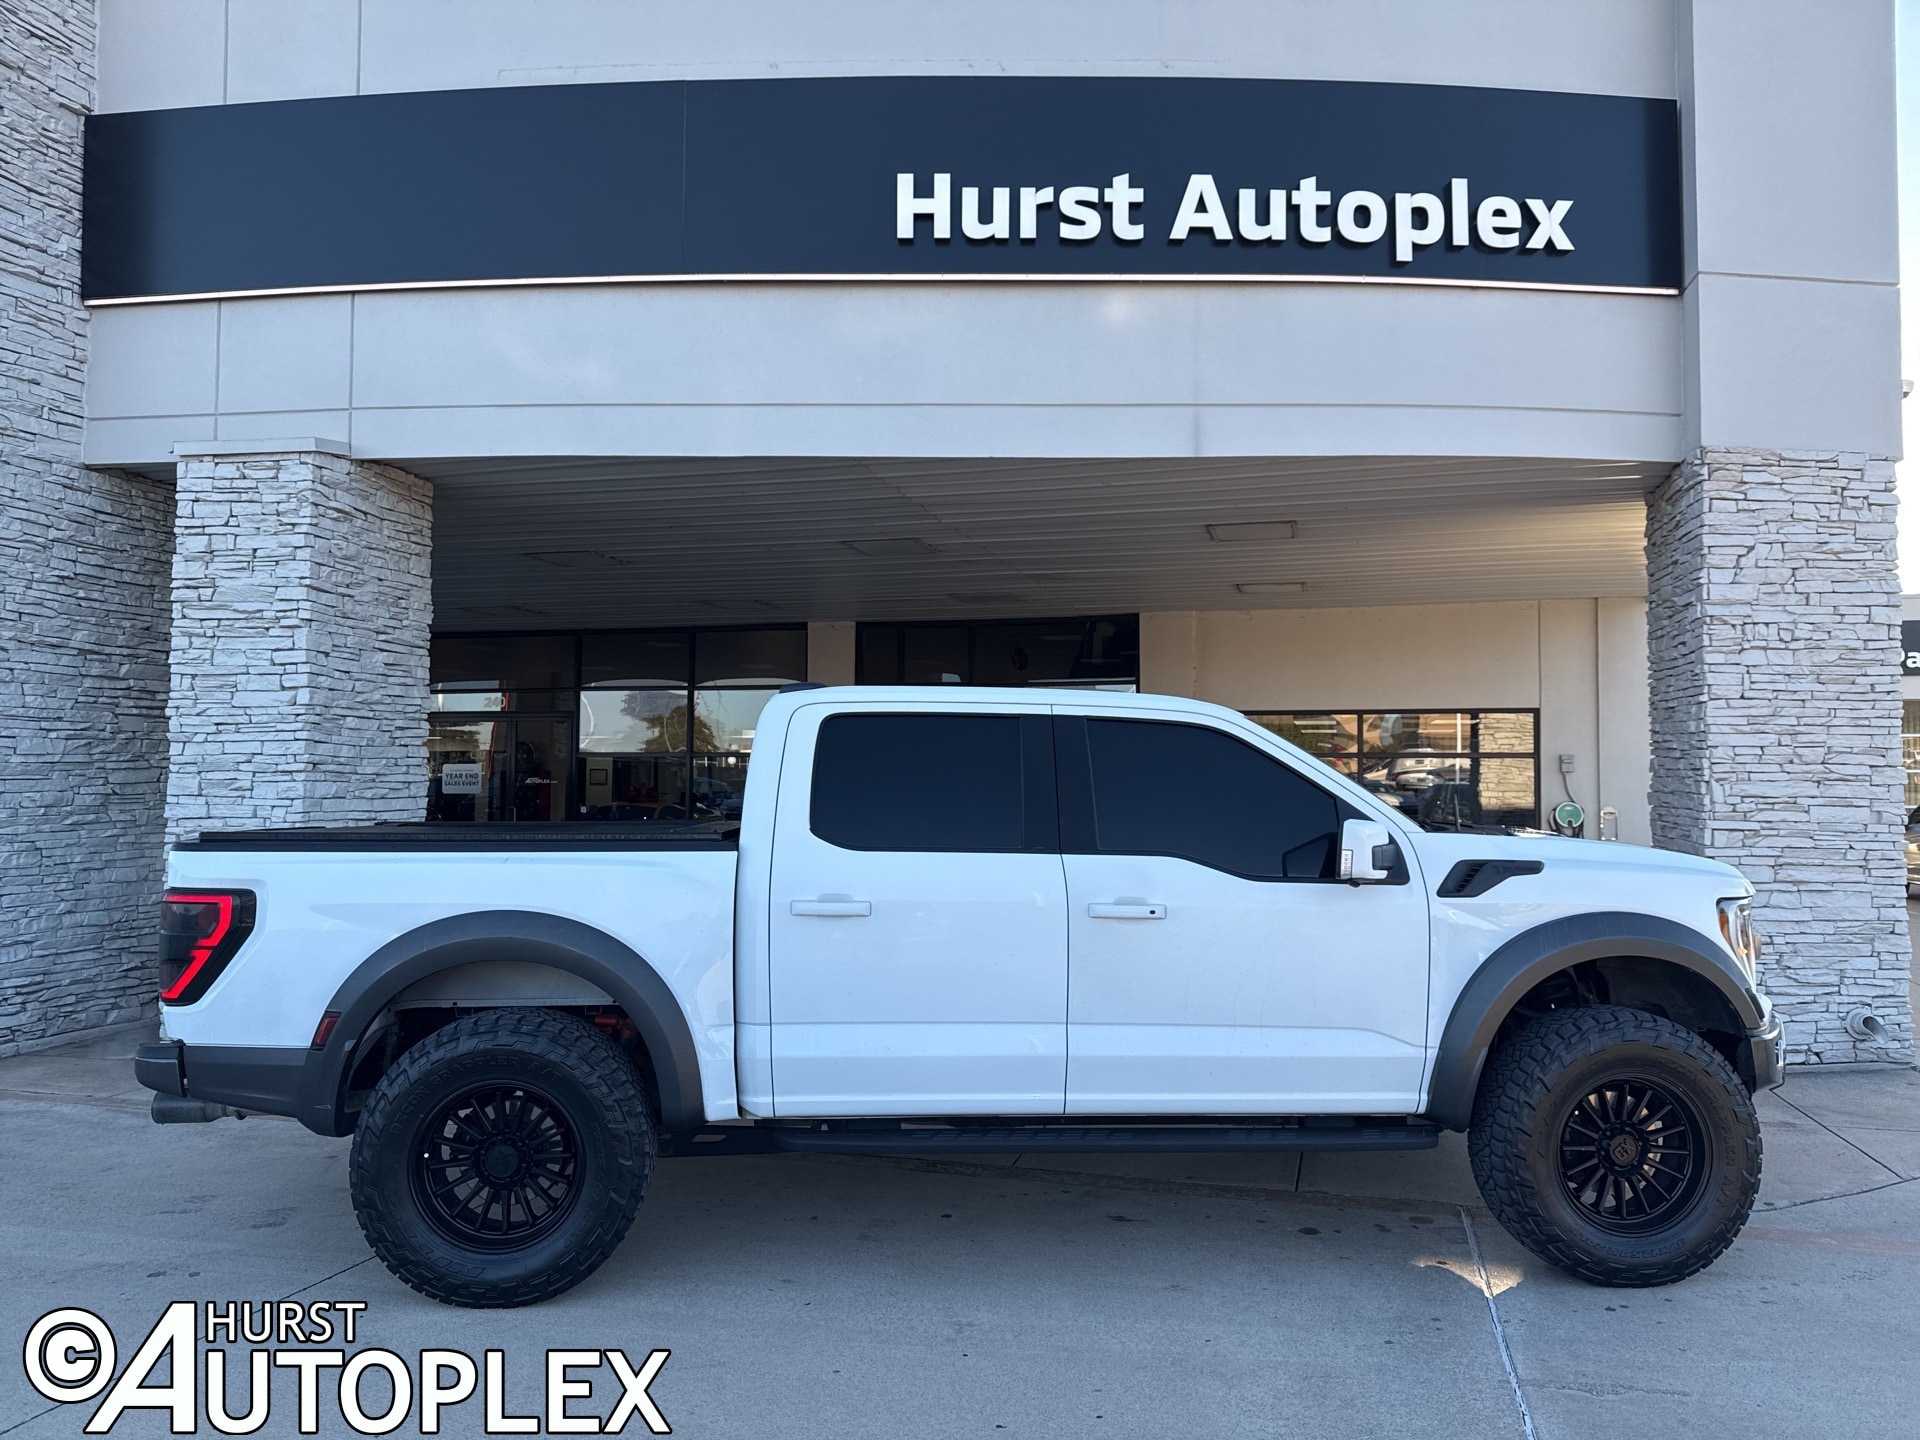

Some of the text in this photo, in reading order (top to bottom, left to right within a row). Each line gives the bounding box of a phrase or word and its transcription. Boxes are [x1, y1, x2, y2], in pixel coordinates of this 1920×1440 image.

[895, 172, 1576, 264] Hurst Autoplex
[484, 696, 506, 708] 240
